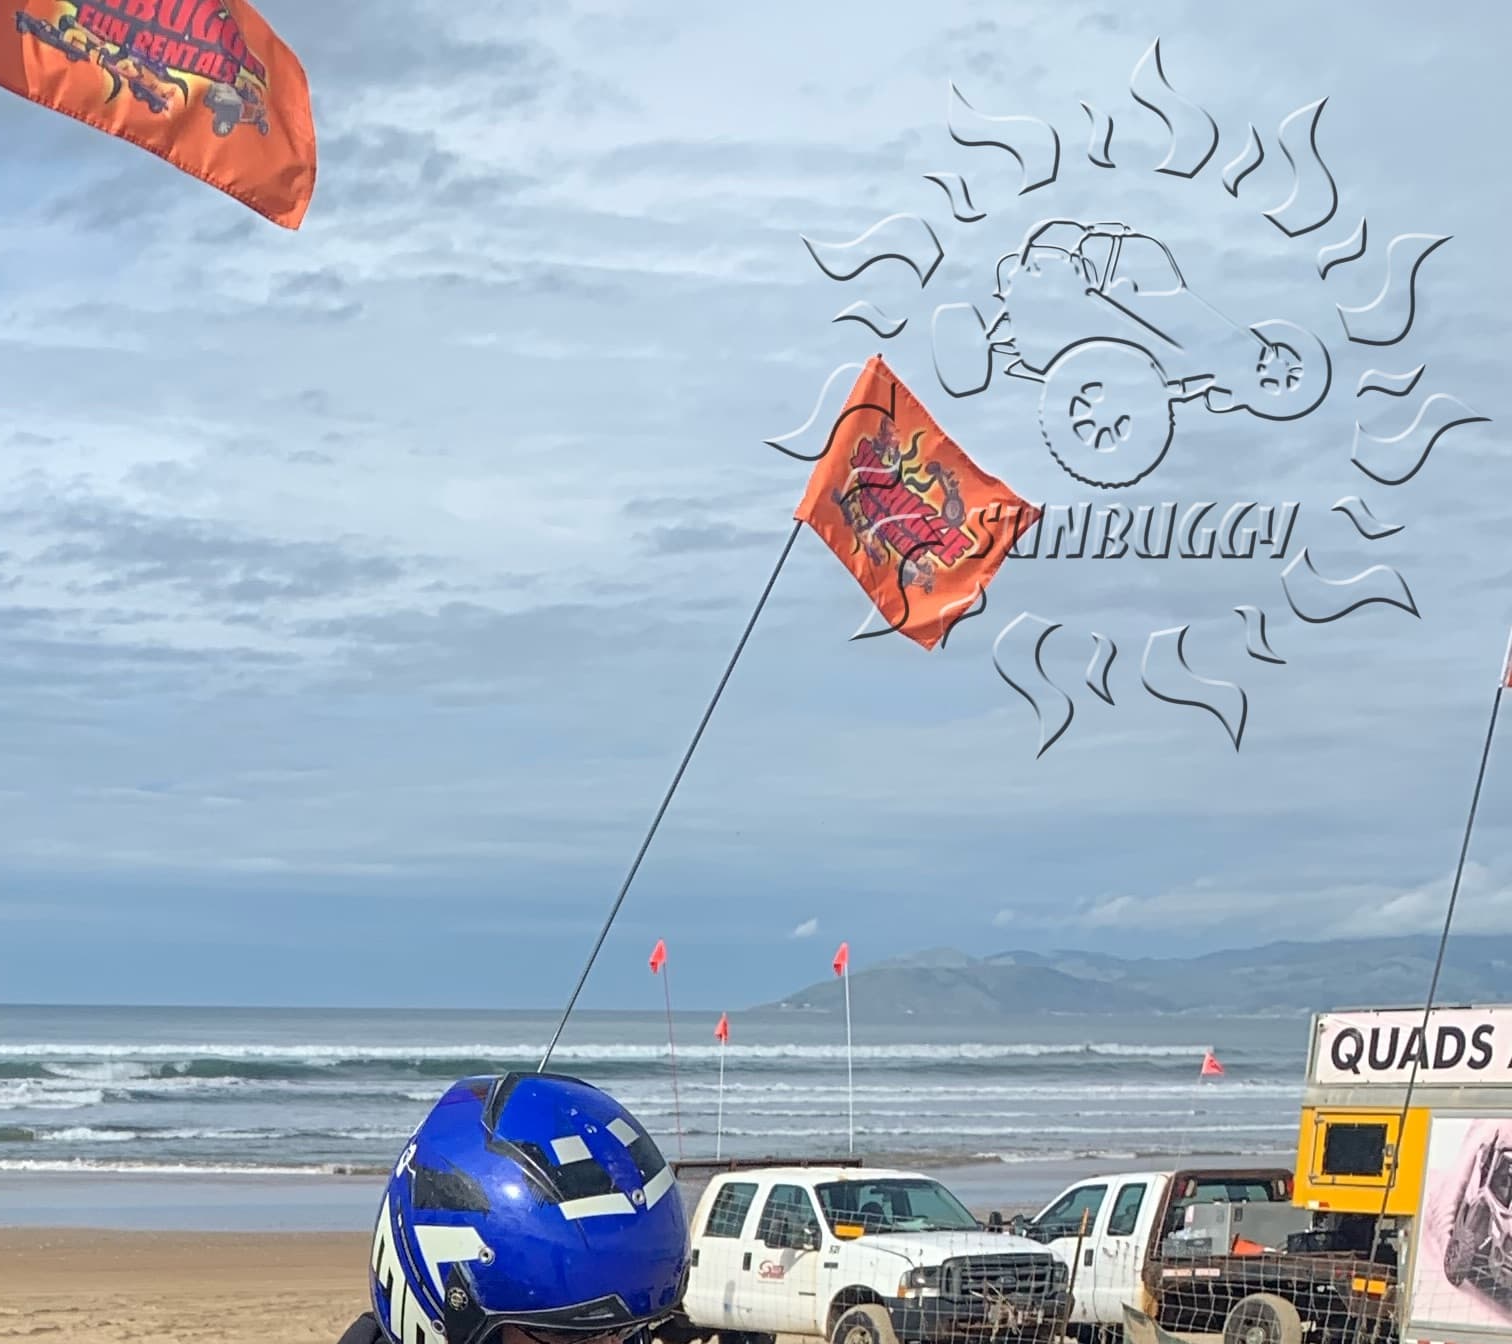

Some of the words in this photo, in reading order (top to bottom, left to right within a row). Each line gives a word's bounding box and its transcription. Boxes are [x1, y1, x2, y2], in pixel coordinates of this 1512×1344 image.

[78, 5, 130, 44] FUN
[134, 30, 241, 85] RENTALS
[1331, 1024, 1495, 1075] QUADS
